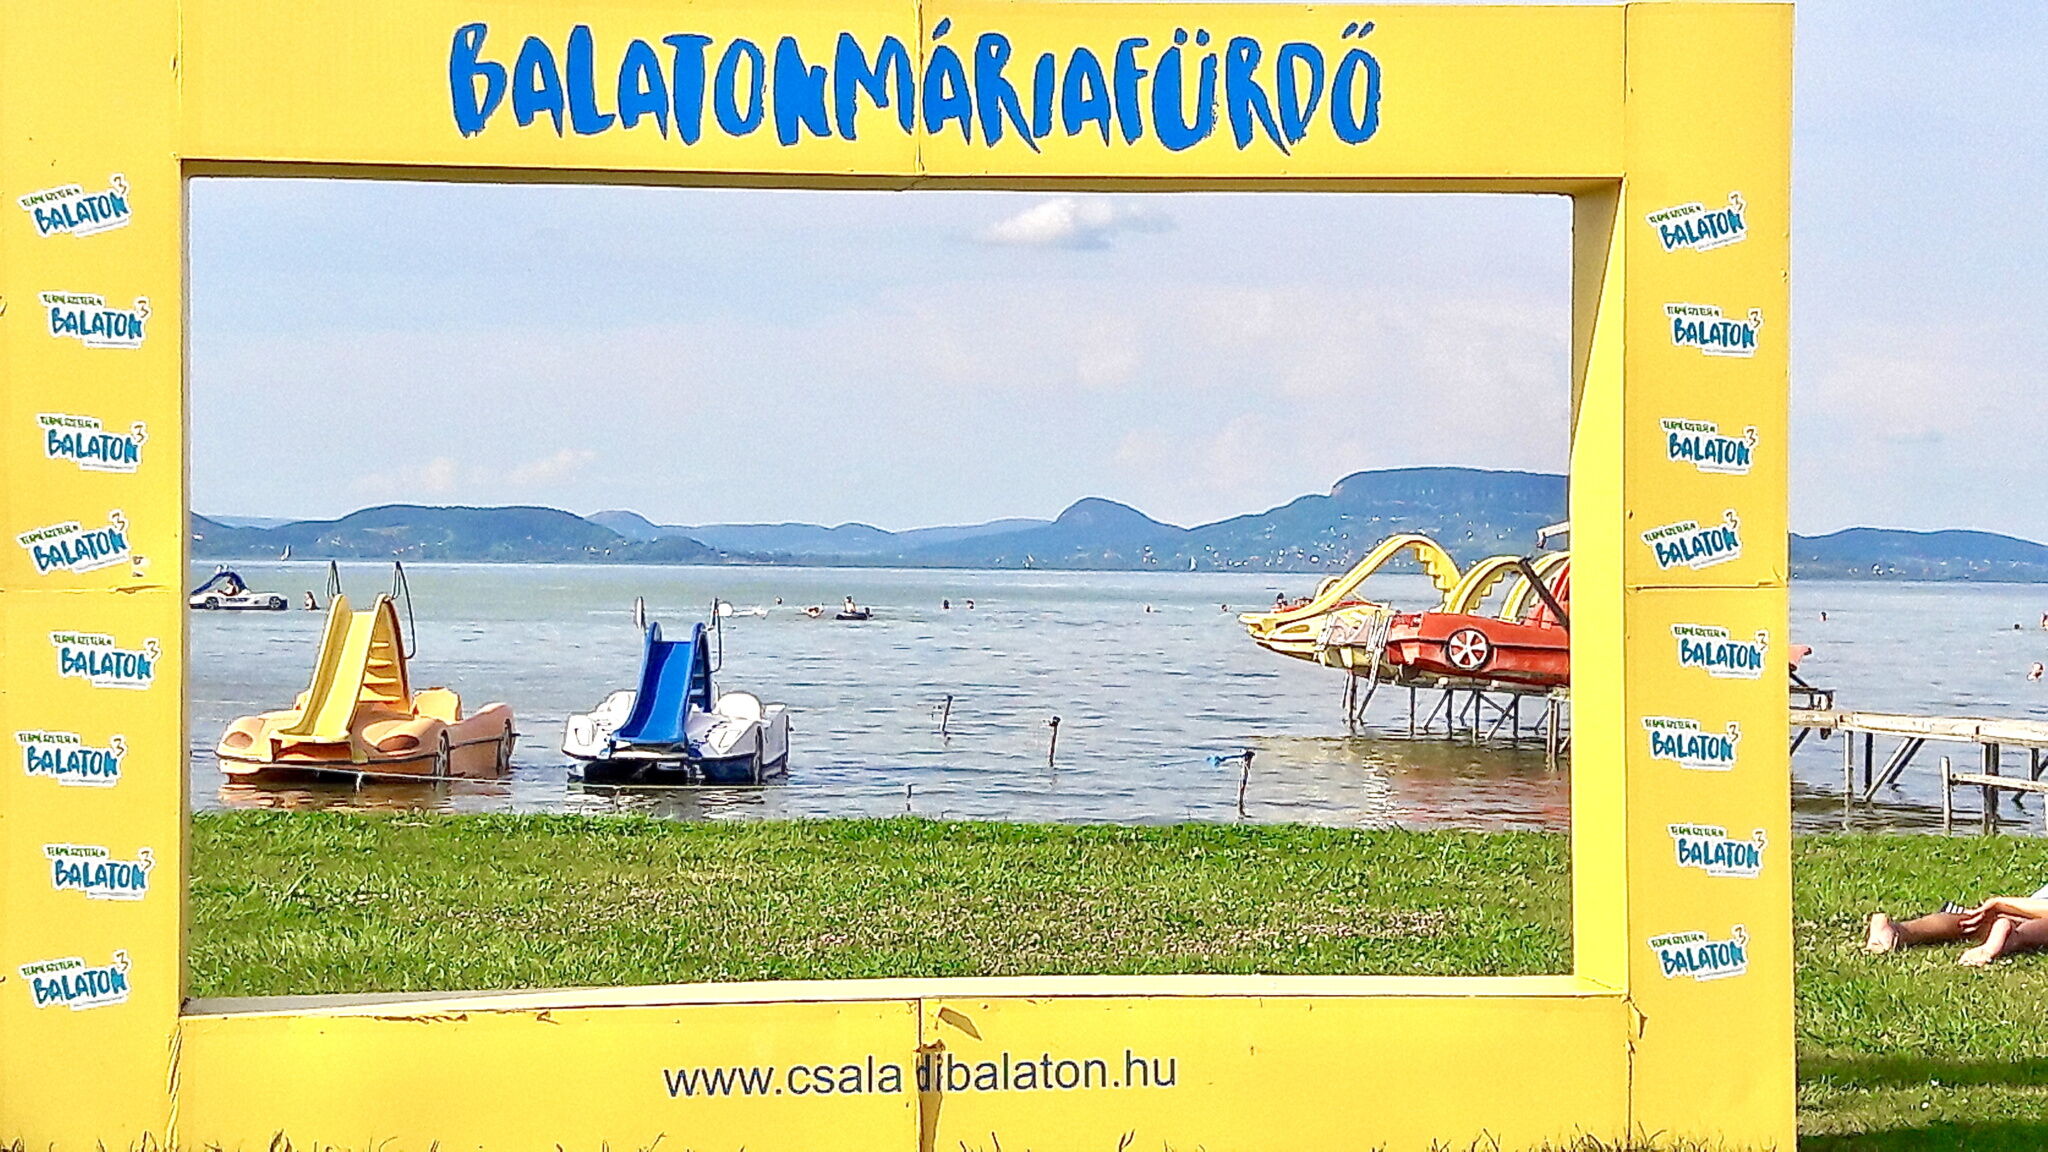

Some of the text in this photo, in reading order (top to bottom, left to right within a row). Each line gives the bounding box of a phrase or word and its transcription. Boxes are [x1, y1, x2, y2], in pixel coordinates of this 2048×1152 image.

[449, 19, 1380, 153] BALATONMÁRIAFÜRDŐ
[34, 192, 129, 233] BALATON
[1660, 209, 1744, 248] BALATON
[51, 307, 143, 339] BALATON
[1674, 317, 1755, 348] BALATON
[48, 428, 138, 464] BALATON
[1670, 432, 1750, 466] BALATON
[33, 529, 128, 570] BALATON
[1655, 527, 1739, 566] BALATON
[61, 647, 152, 680] BALATON
[1681, 638, 1762, 670] BALATON
[27, 746, 118, 777] BALATON
[1652, 731, 1734, 762] BALATON
[1678, 838, 1760, 869] BALATON
[55, 859, 146, 890] BALATON
[1661, 942, 1745, 974] BALATON
[33, 968, 127, 1003] BALATON
